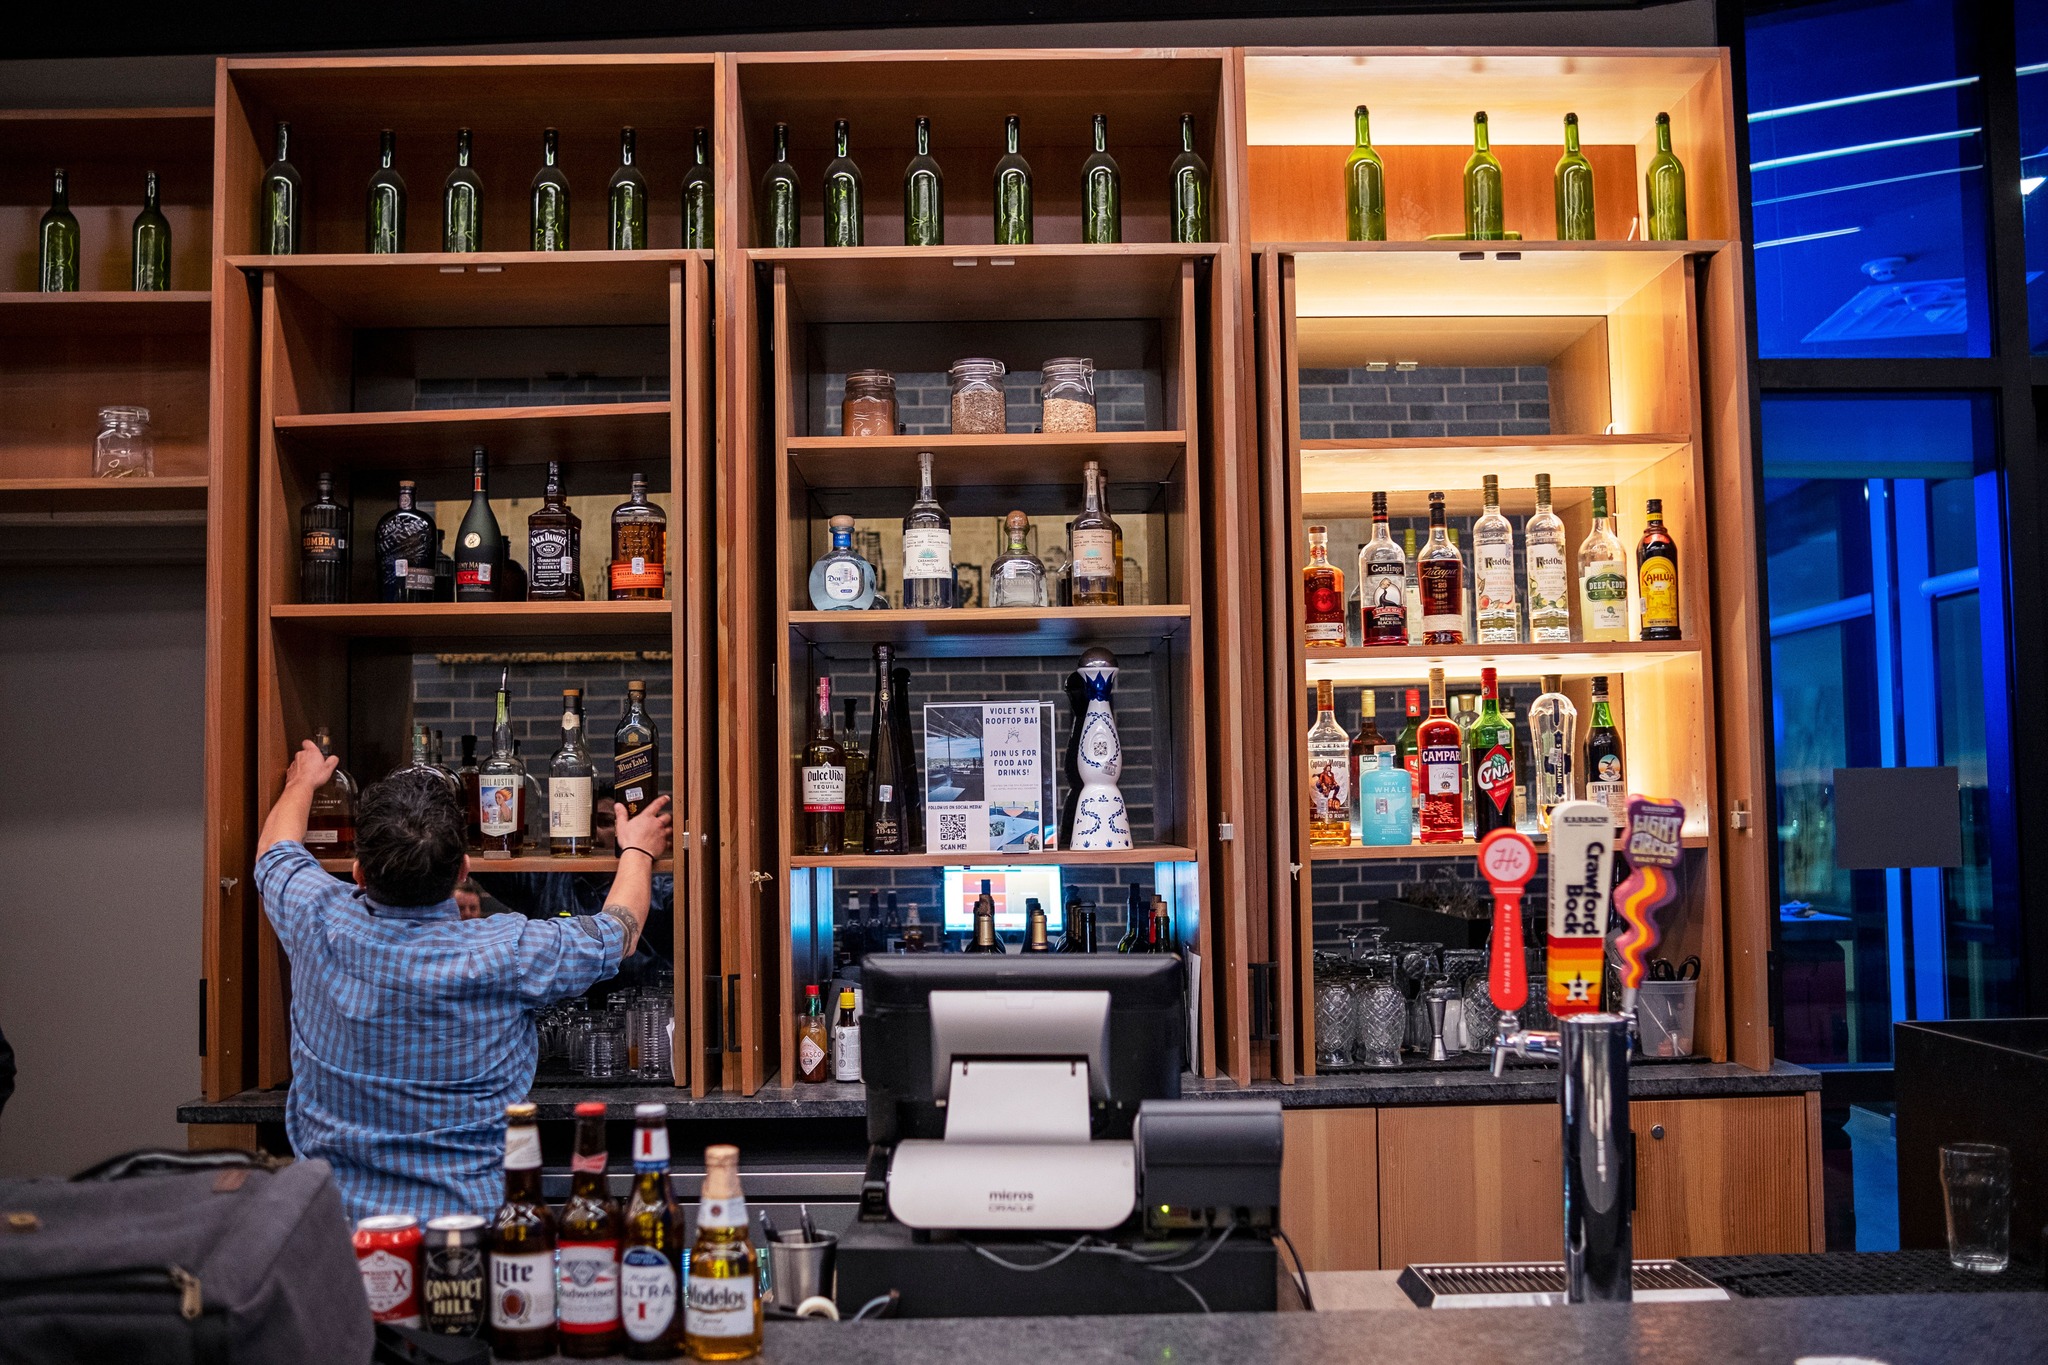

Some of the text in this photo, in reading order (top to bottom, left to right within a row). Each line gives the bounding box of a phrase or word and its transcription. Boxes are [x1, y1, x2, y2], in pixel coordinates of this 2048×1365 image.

[531, 535, 545, 547] JACK
[1485, 556, 1512, 568] Ketel One
[1536, 556, 1563, 568] Ketel One
[1371, 564, 1402, 574] Goslings
[1641, 570, 1676, 587] KAHLÚA
[1588, 581, 1626, 590] DEEP EDDY
[1337, 624, 1343, 633] 8
[989, 707, 1017, 715] VIOLET
[990, 750, 1007, 758] JOIN
[1422, 750, 1461, 763] CAMPAR
[618, 760, 632, 772] Blue
[632, 755, 648, 768] Label
[1017, 759, 1033, 767] AND
[807, 769, 844, 782] Dulce Vida
[997, 769, 1030, 777] DRINKS!
[1477, 760, 1515, 791] CYNAR
[480, 777, 514, 786] STILL AUSTIN
[1632, 813, 1682, 843] LIGHT
[940, 843, 956, 851] SCAN
[1629, 832, 1680, 857] CIRCUS
[1492, 848, 1523, 873] Hi
[1582, 841, 1605, 935] Crawford
[1563, 884, 1585, 935] Bock
[1503, 926, 1511, 948] SIGN
[1503, 951, 1511, 994] BREWING
[988, 1189, 1034, 1201] micros
[496, 1260, 533, 1288] Lite
[424, 1278, 482, 1301] CONVICT
[433, 1299, 473, 1315] HILL
